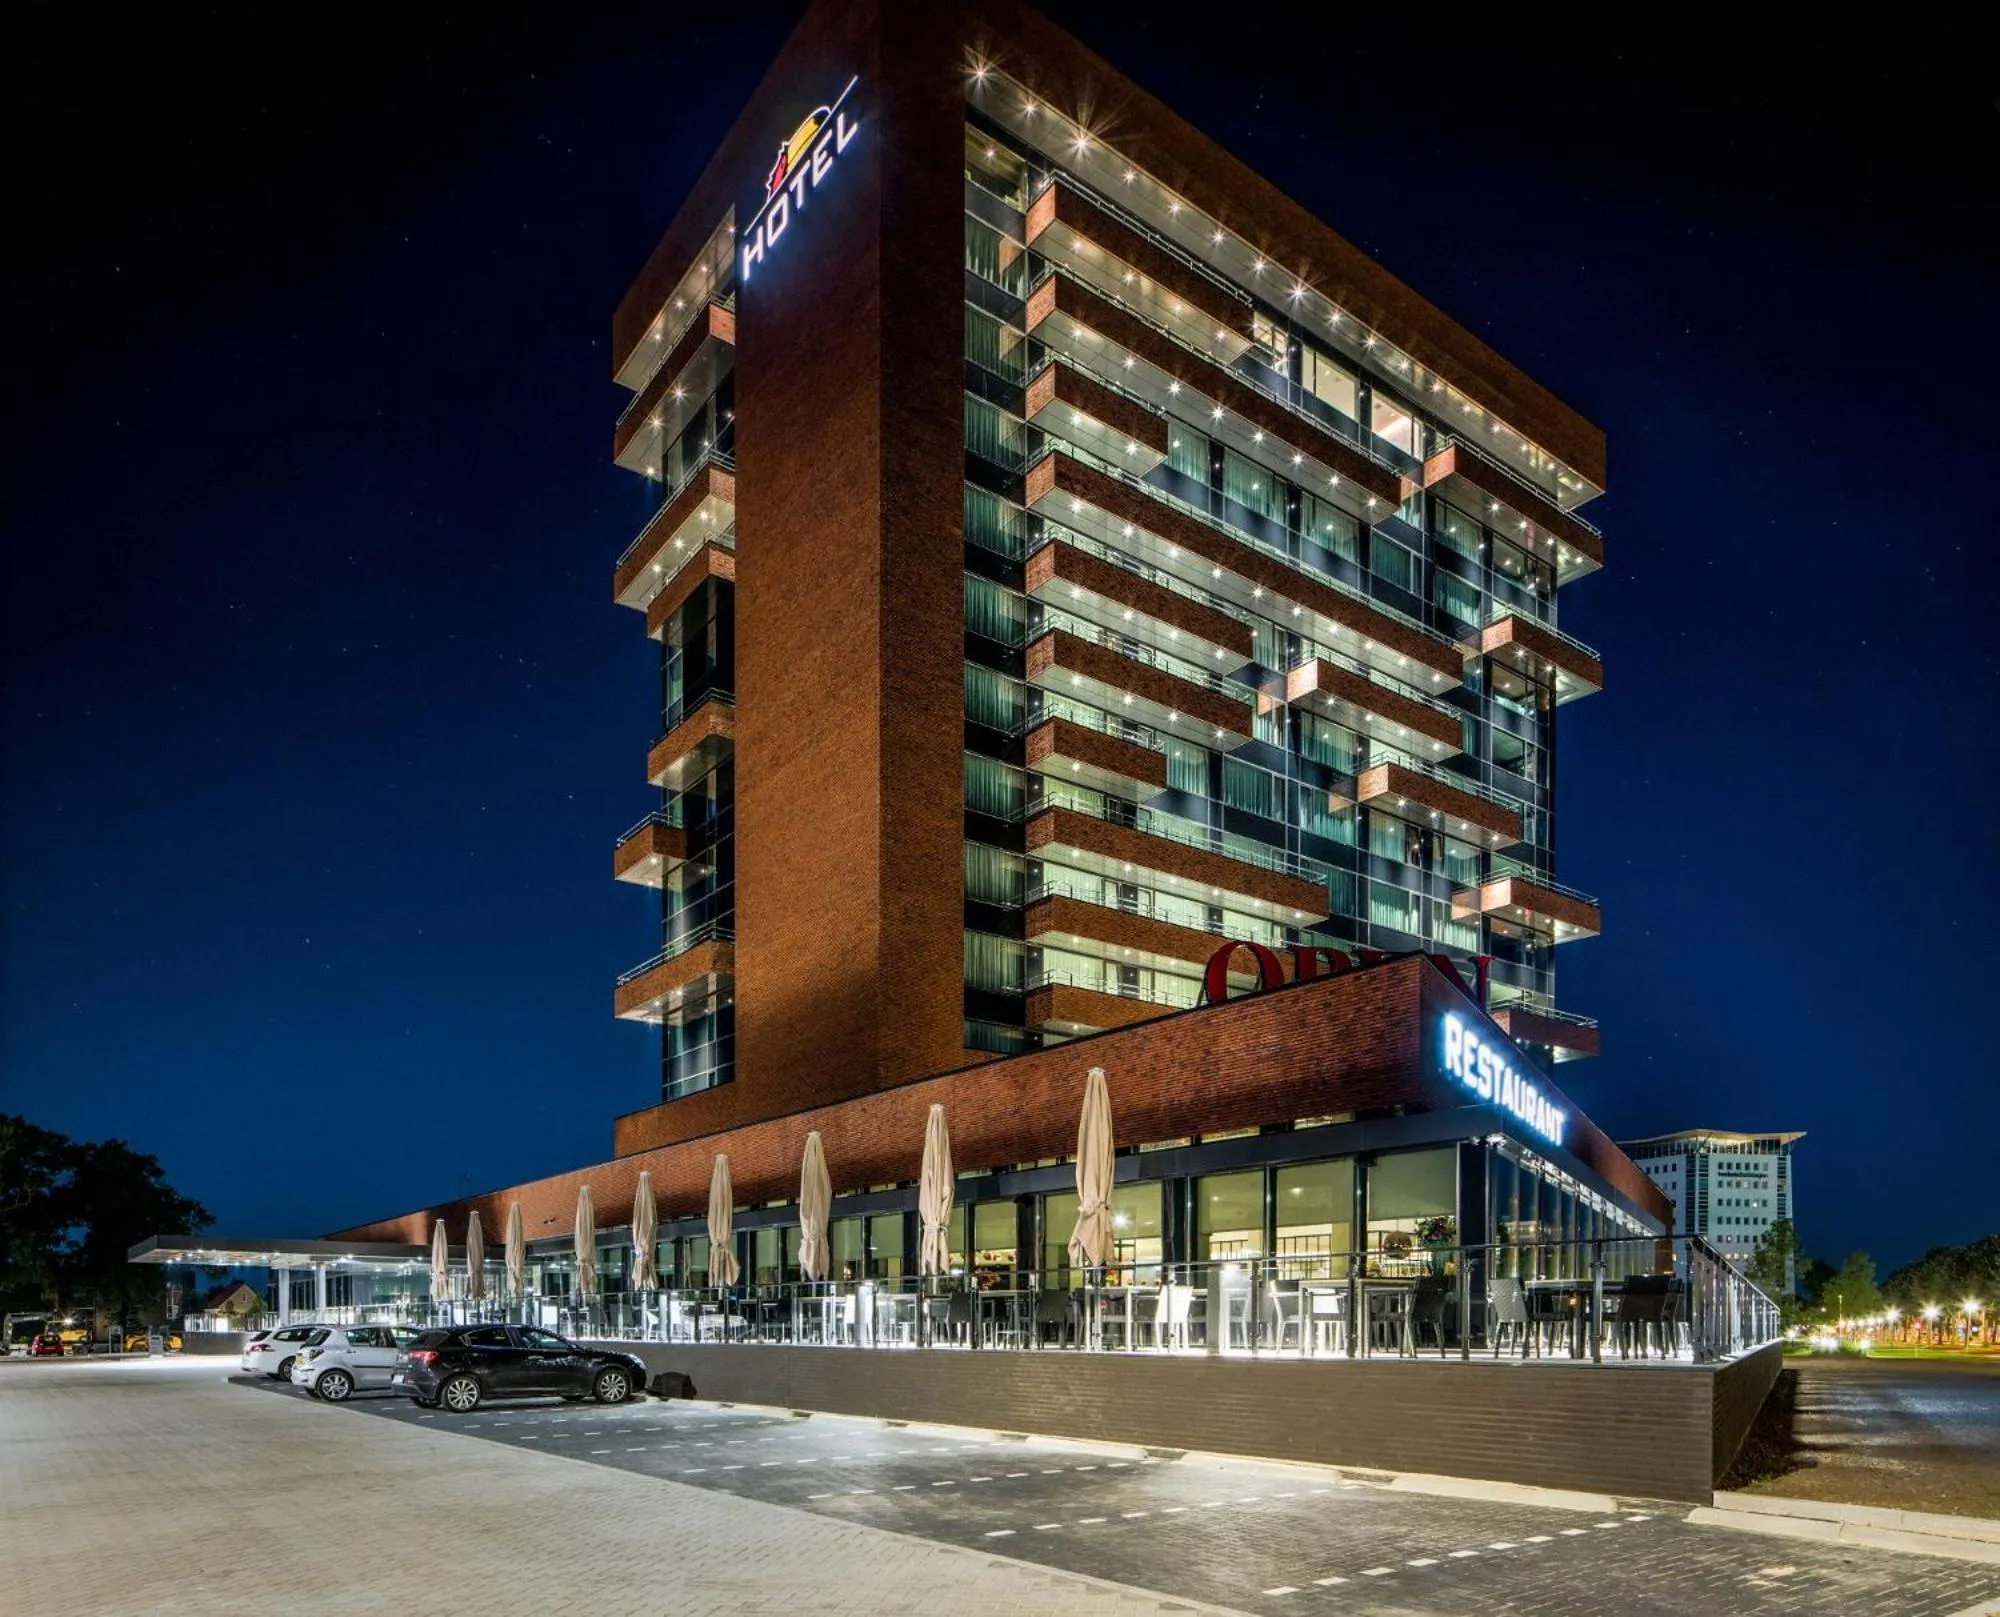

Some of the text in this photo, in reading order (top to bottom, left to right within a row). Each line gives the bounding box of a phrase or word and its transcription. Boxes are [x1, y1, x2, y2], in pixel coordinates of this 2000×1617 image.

[743, 112, 858, 281] HOTEL
[1204, 940, 1494, 1008] OPN
[1445, 1013, 1565, 1147] RESTAURANT
